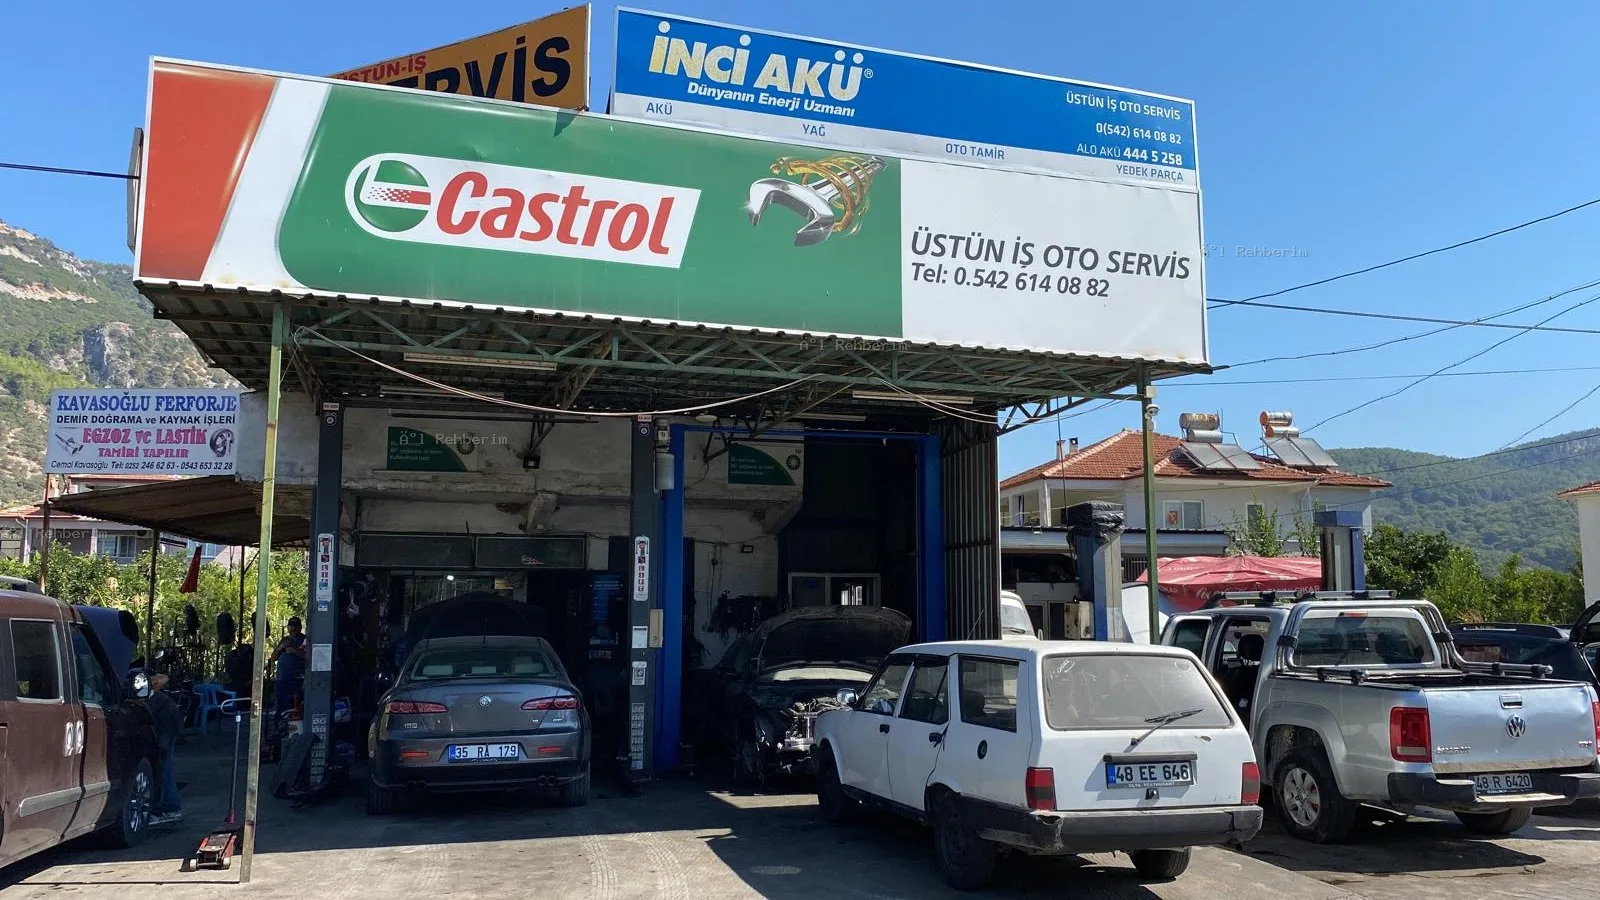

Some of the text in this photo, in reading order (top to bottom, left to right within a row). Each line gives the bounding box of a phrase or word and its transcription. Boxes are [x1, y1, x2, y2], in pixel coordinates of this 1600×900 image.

[648, 21, 751, 86] İNCİ
[687, 82, 856, 117] Dünyanın Enerji Uzmanı
[1066, 90, 1181, 120] ÜSTÜN İŞ OTO SERVİS
[646, 102, 673, 116] AKÜ
[802, 124, 826, 137] YAĞ
[1095, 122, 1182, 145] 0(542) 614 08 82
[945, 143, 1005, 160] OTO TAMİR
[1076, 143, 1183, 166] ALO AKÜ 444 5 258
[1116, 164, 1184, 182] YEDEK PARÇA
[436, 171, 676, 255] Castrol
[911, 226, 1191, 280] ÜSTÜN İŞ OTO SERVİS
[911, 262, 1110, 298] Tel: 0.542 614 08 82
[57, 391, 237, 412] KAVASOĞLU FERFORJE
[56, 413, 88, 424] DEMİR
[91, 413, 142, 424] DOĞRAMA
[160, 415, 201, 424] KAYNAK
[203, 413, 236, 426] İŞLERİ
[82, 427, 131, 444] EGZOZ
[155, 425, 208, 444] LASTİK
[98, 446, 189, 458] TAMİRİ YAPILIR
[51, 460, 73, 469] Cemal
[74, 460, 108, 471] Kavasoğlu
[111, 461, 124, 469] Tel:
[124, 462, 140, 470] 0252
[141, 461, 155, 470] 246
[156, 461, 166, 470] 62
[166, 461, 176, 470] 63
[180, 461, 198, 470] 0543
[199, 461, 212, 470] 653
[213, 461, 223, 470] 32
[223, 461, 233, 470] 28
[455, 745, 517, 758] 35 RA 179
[1116, 764, 1189, 781] 48 EE 646
[1476, 774, 1530, 789] 48 R 6420
